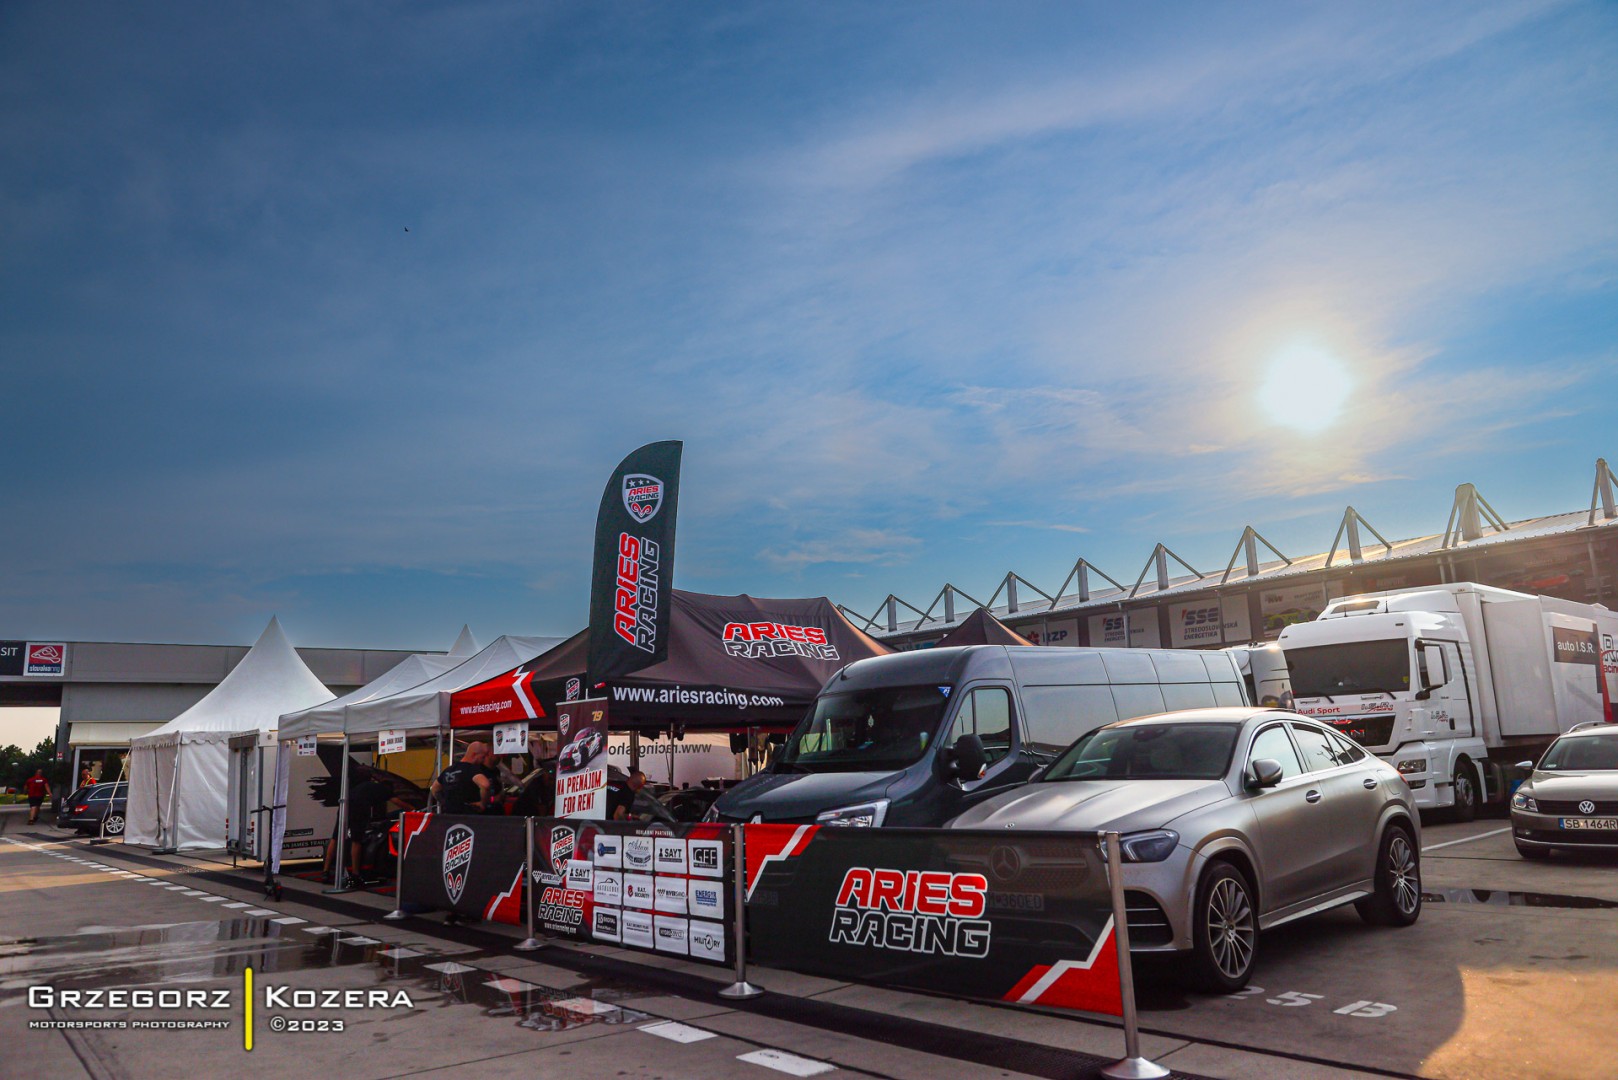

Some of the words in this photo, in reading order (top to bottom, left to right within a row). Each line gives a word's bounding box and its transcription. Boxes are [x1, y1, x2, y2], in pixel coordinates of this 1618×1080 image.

[628, 485, 659, 496] ARIES
[628, 492, 660, 502] RACING
[614, 532, 640, 646] ARIES
[636, 537, 660, 654] RACING
[1185, 607, 1219, 626] SSE
[722, 622, 828, 646] ARIES
[1184, 620, 1238, 634] STREDOSLOVNSKÁ
[1184, 631, 1218, 641] ENERGETIKA
[0, 647, 19, 657] SIT
[723, 640, 840, 660] RACING
[1557, 641, 1575, 652] auto
[1576, 641, 1596, 654] I.S.R.
[612, 685, 785, 710] www.ariesracing.com
[460, 699, 513, 716] www.ariesracing.com
[1316, 706, 1341, 716] Sport
[556, 778, 565, 797] NA
[566, 769, 602, 796] PRENÁJOM
[562, 796, 577, 815] FOR
[577, 791, 595, 812] RENT
[1565, 819, 1580, 829] SB
[1584, 819, 1617, 829] 1464R
[445, 838, 472, 862] ARIES
[552, 843, 573, 859] RACING
[553, 835, 573, 850] ARIES
[444, 851, 470, 872] RACING
[664, 848, 682, 858] SAYT
[574, 867, 591, 878] SAYT
[541, 886, 586, 909] ARIES
[835, 866, 988, 919] ARIES
[538, 904, 584, 926] RACING
[828, 906, 992, 959] RACING
